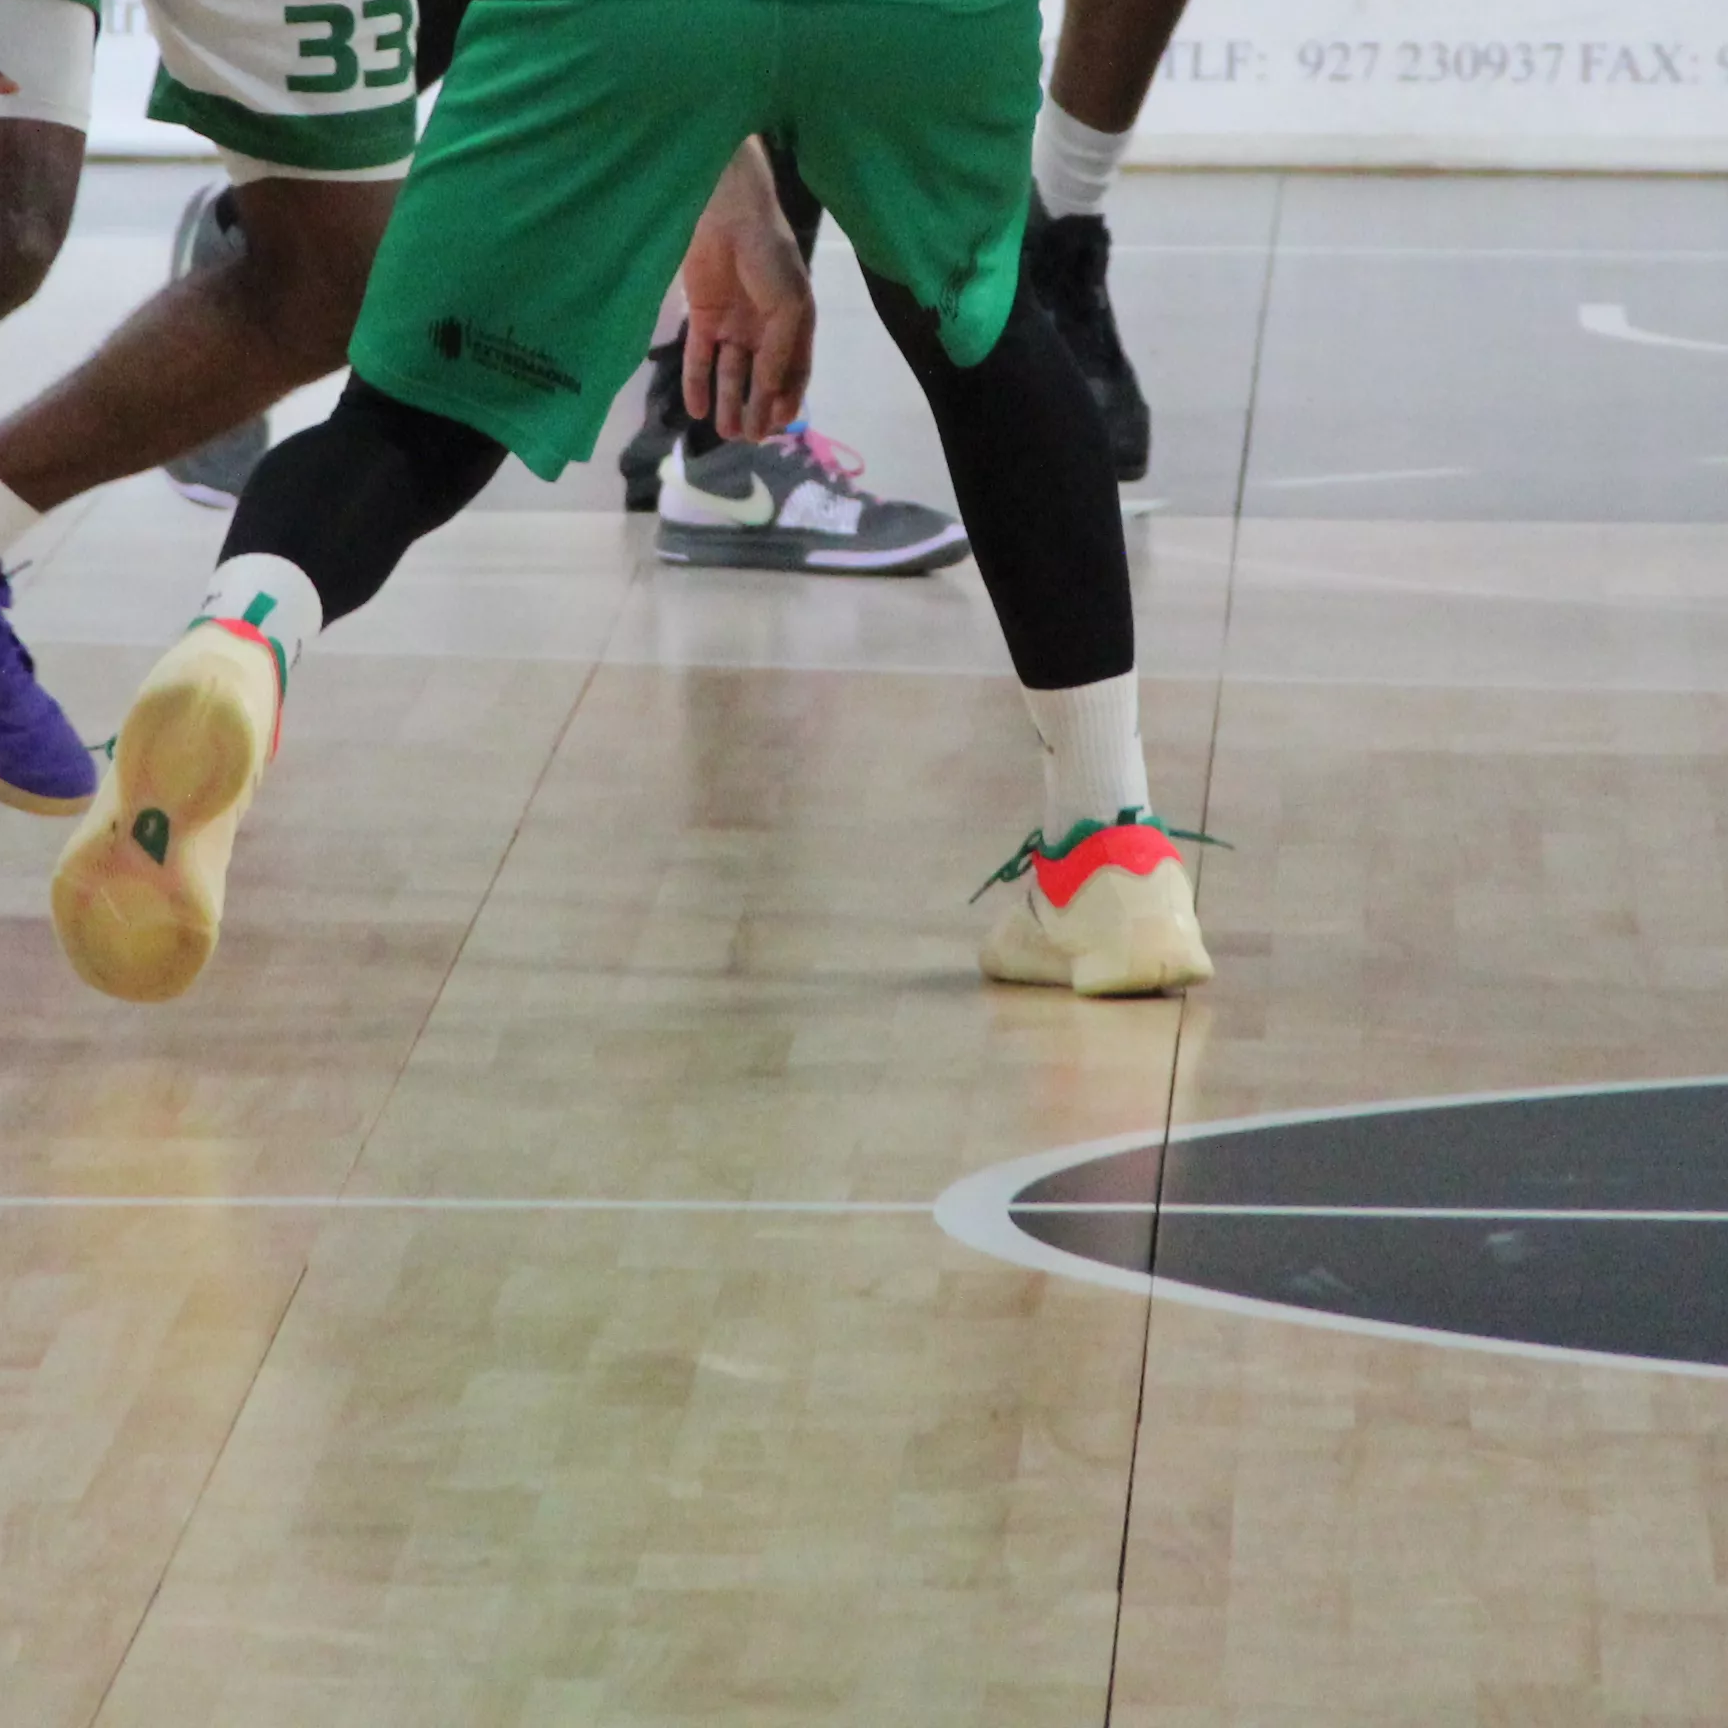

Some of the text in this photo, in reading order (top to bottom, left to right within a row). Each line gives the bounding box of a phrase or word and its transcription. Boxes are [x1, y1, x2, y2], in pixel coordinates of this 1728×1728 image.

[1297, 40, 1382, 83] 927
[1396, 40, 1566, 84] 230937
[1578, 41, 1698, 85] FAX:
